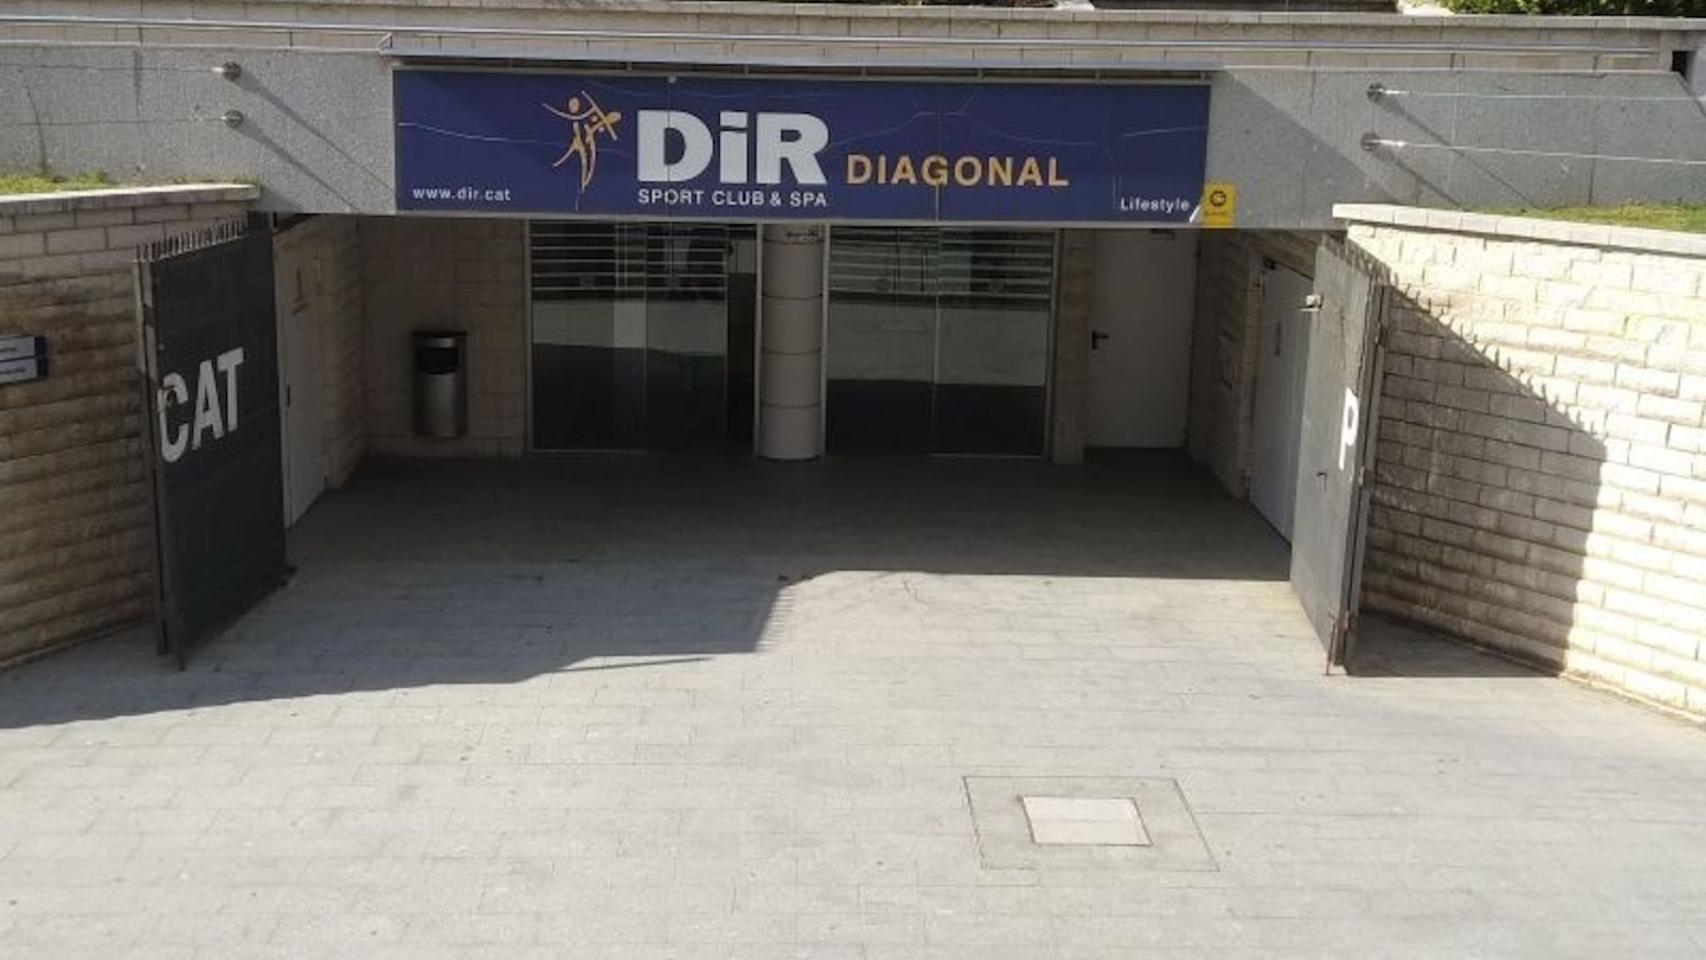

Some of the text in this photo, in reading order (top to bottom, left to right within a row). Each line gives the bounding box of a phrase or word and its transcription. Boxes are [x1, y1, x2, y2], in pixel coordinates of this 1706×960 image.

[637, 109, 829, 185] DiR
[847, 154, 1069, 187] DIAGONAL
[412, 187, 511, 201] www.dir.cat
[638, 188, 828, 207] SPORT CLUB & SPA
[1120, 197, 1190, 213] Lifestyle
[157, 346, 245, 463] CAT
